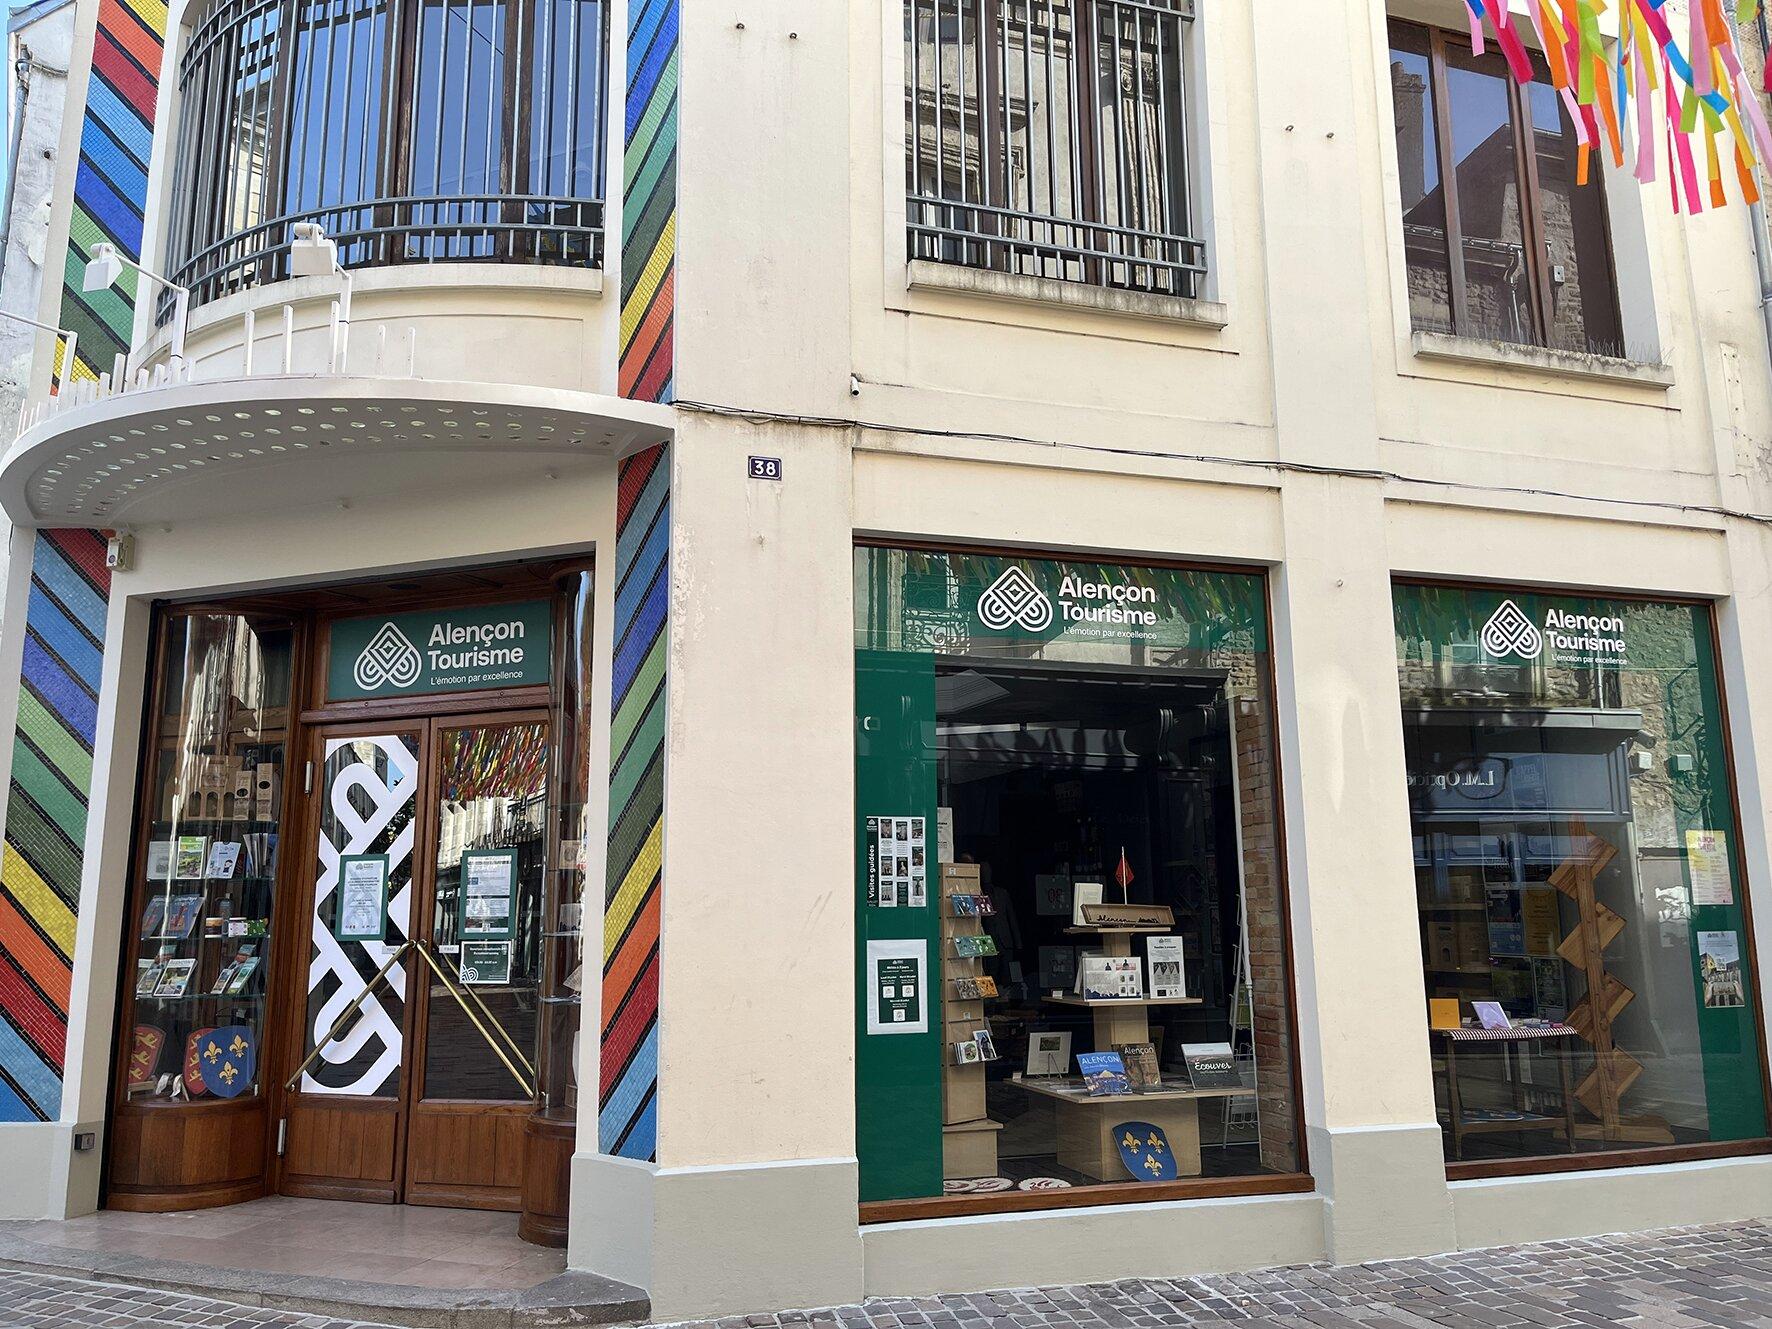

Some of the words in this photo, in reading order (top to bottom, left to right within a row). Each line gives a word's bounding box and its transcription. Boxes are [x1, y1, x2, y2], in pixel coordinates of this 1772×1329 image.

[754, 460, 776, 476] 38
[1058, 576, 1156, 606] Alençon
[1058, 601, 1157, 626] Tourisme
[1545, 608, 1624, 636] Alençon
[428, 621, 525, 647] Alençon
[1063, 626, 1101, 636] L'émotion
[1102, 630, 1116, 638] par
[1117, 630, 1158, 640] excellence
[1545, 630, 1626, 653] Tourisme
[428, 646, 524, 670] Tourisme
[1551, 653, 1583, 663] L'émotion
[1583, 657, 1594, 665] par
[1594, 657, 1628, 666] excellence
[430, 676, 467, 686] L'émotion
[468, 673, 481, 684] par
[482, 670, 523, 681] excellence
[868, 844, 877, 873] guidées
[868, 874, 876, 898] Visites
[1081, 1054, 1121, 1065] ALENÇON
[1124, 1046, 1155, 1056] Alençon
